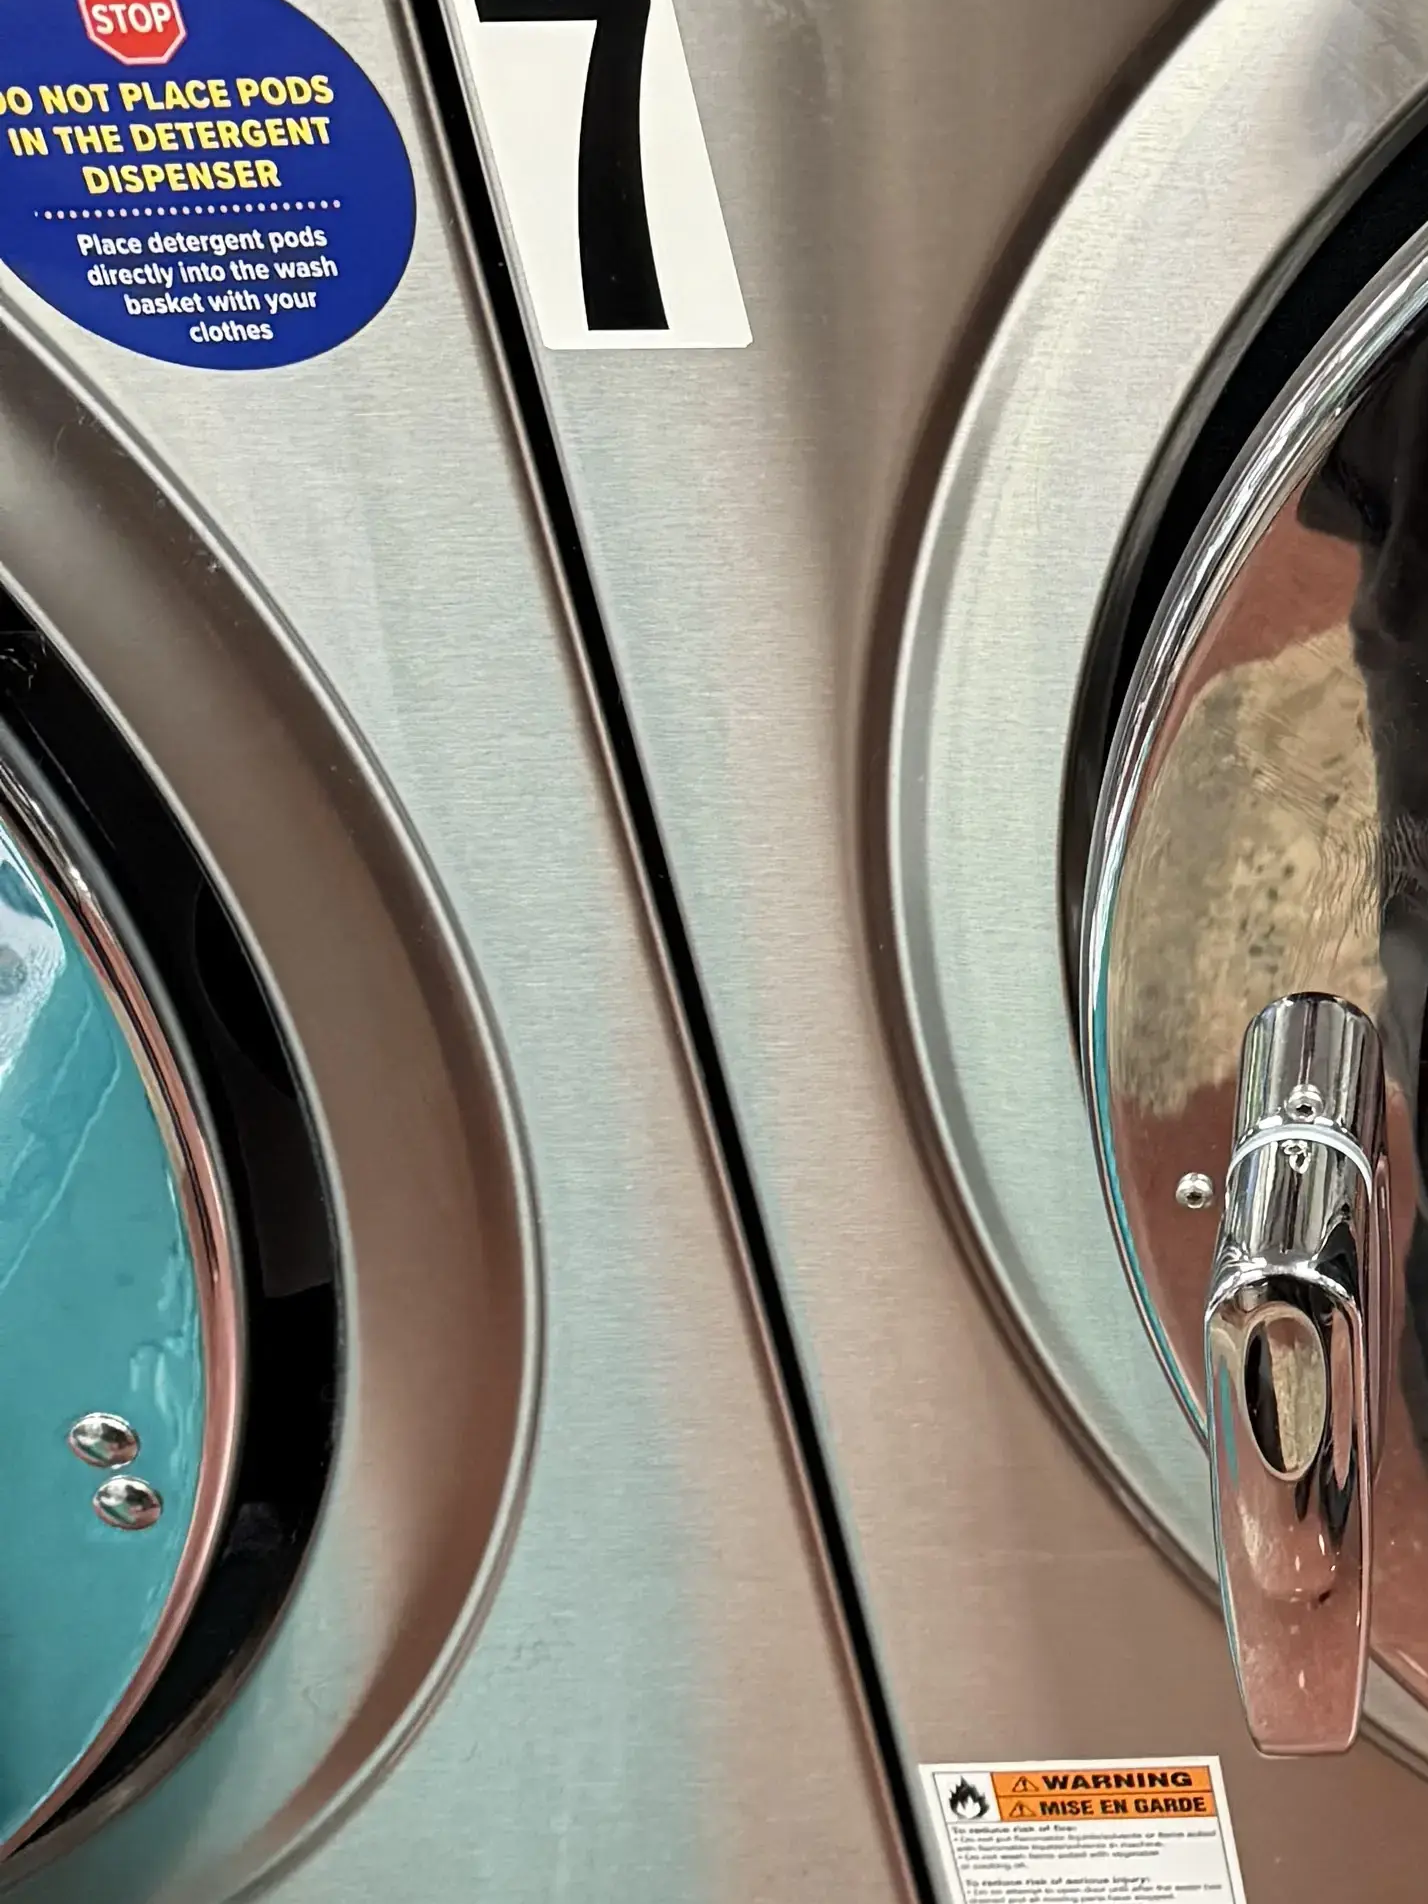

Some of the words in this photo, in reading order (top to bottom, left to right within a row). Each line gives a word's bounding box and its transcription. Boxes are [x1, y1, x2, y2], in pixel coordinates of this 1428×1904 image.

[92, 2, 171, 34] STOP
[39, 84, 109, 114] NOT
[119, 79, 231, 111] PLACE
[236, 75, 333, 106] PODS
[8, 128, 48, 156] IN
[53, 125, 124, 154] THE
[129, 117, 330, 151] DETERGENT
[82, 160, 281, 194] DISPENSER
[77, 234, 143, 256] Place
[148, 229, 264, 255] detergent
[268, 226, 327, 253] pods
[88, 263, 173, 288] directly
[178, 261, 225, 283] into
[230, 260, 269, 280] the
[274, 256, 338, 278] wash
[124, 292, 205, 314] basket
[208, 290, 260, 311] with
[264, 292, 316, 314] your
[190, 320, 273, 342] clothes
[1042, 1772, 1192, 1790] WARNING
[1040, 1800, 1094, 1815] MISE
[1100, 1799, 1128, 1814] EN
[1134, 1797, 1206, 1813] GARDE
